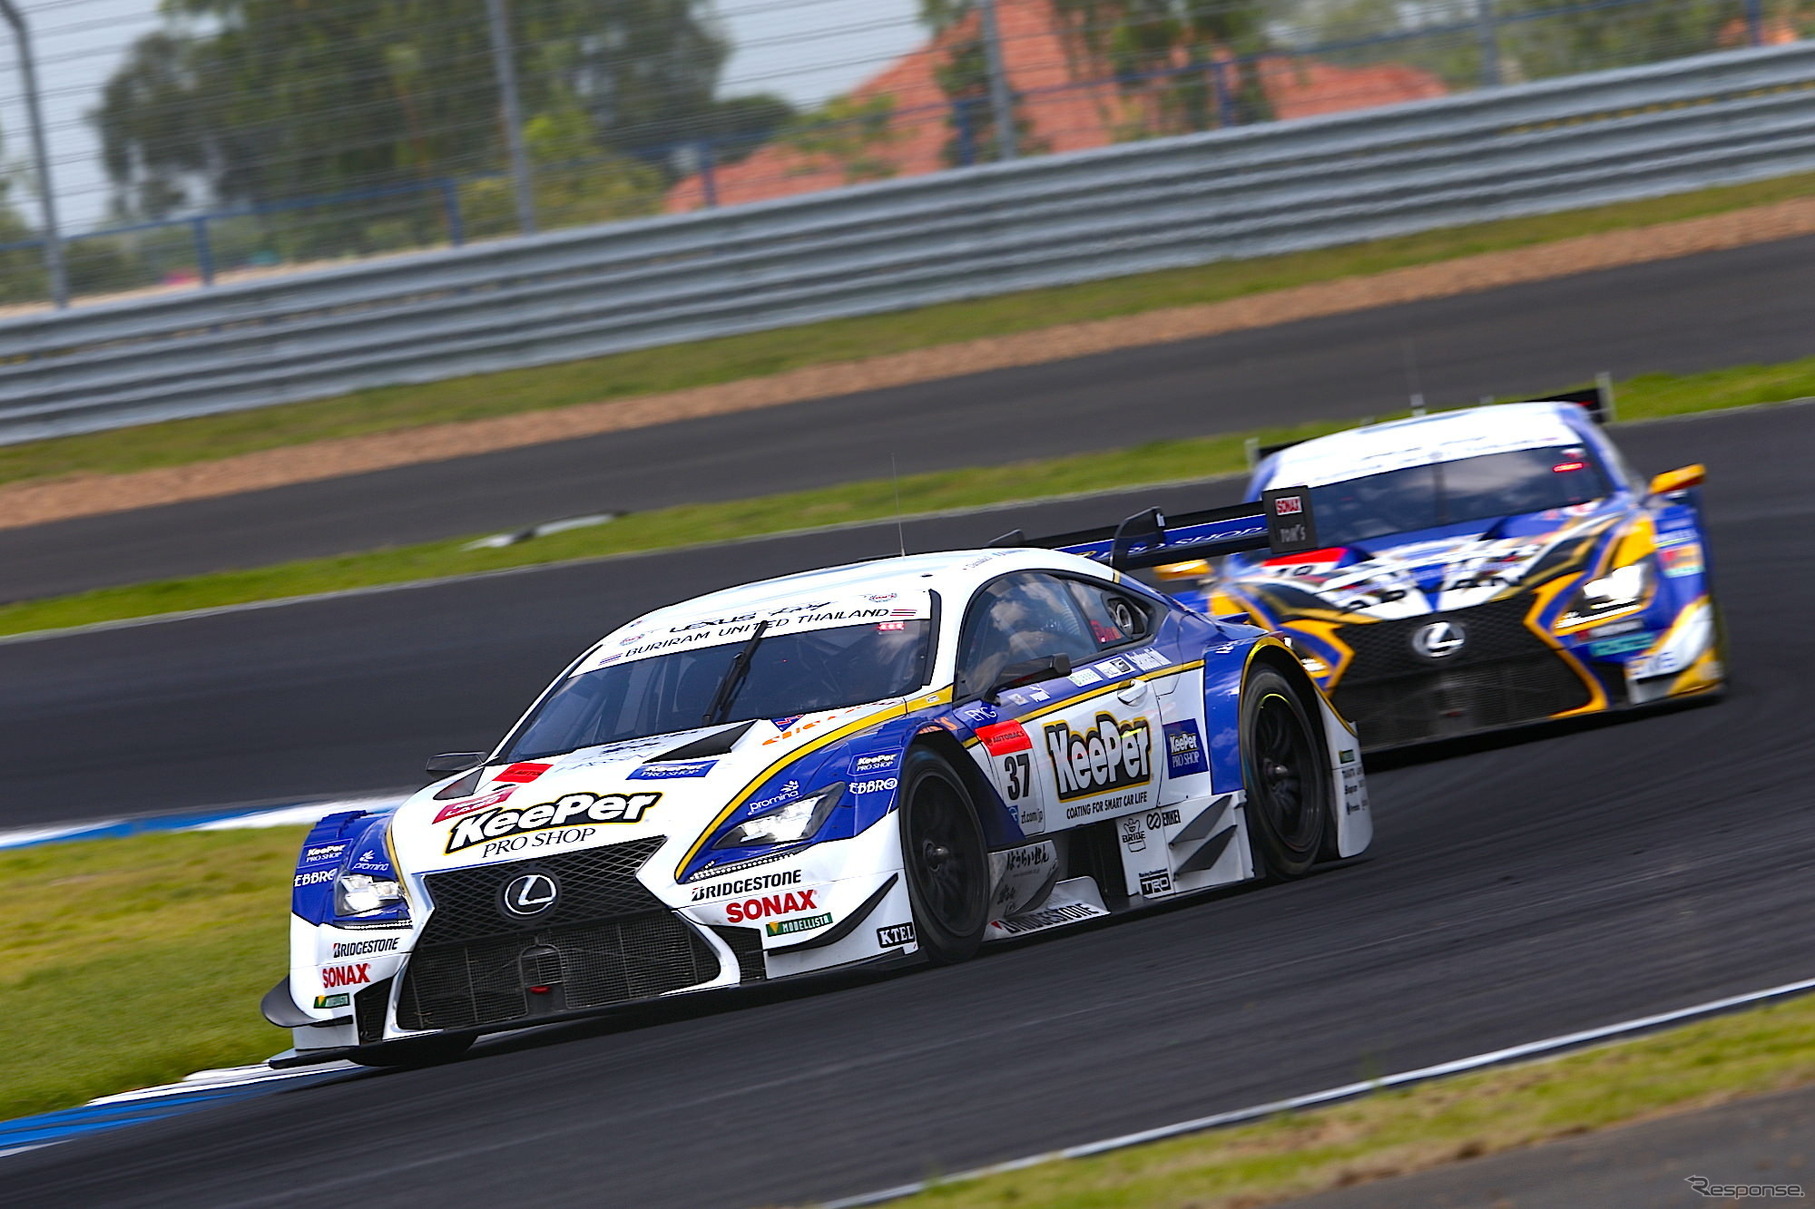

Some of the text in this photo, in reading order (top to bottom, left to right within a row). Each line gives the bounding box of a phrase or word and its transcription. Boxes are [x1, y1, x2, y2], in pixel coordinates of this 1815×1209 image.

[625, 632, 710, 657] BURIRAM
[718, 618, 789, 637] UNITED
[797, 608, 889, 624] THAILAND
[669, 612, 757, 633] LEXUS
[992, 730, 1026, 744] AUTOBACS
[1169, 732, 1198, 754] KeePer
[856, 761, 894, 772] PRO SHOP
[857, 754, 897, 766] KeePer
[1045, 715, 1151, 800] KeePer
[1172, 752, 1201, 769] PRO SHOP
[666, 769, 700, 777] SHOP
[1004, 754, 1031, 801] 37
[848, 777, 898, 795] EBBRO
[747, 789, 800, 816] promina
[1066, 791, 1148, 820] COATING FOR SMART CAR LIFE
[446, 793, 663, 854] KeePer
[482, 827, 596, 858] PRO SHOP
[1122, 831, 1146, 844] BRIDE
[305, 852, 343, 863] PRO SHOP
[307, 844, 347, 857] KeePer
[691, 869, 802, 902] BRIDGESTONE
[1142, 877, 1170, 893] TRD
[725, 889, 818, 923] SONAX
[782, 914, 831, 932] MODELLISTA
[990, 902, 1100, 934] BRIDGESTONE
[333, 937, 401, 959] BRIDGESTONE
[322, 963, 371, 989] SONAX
